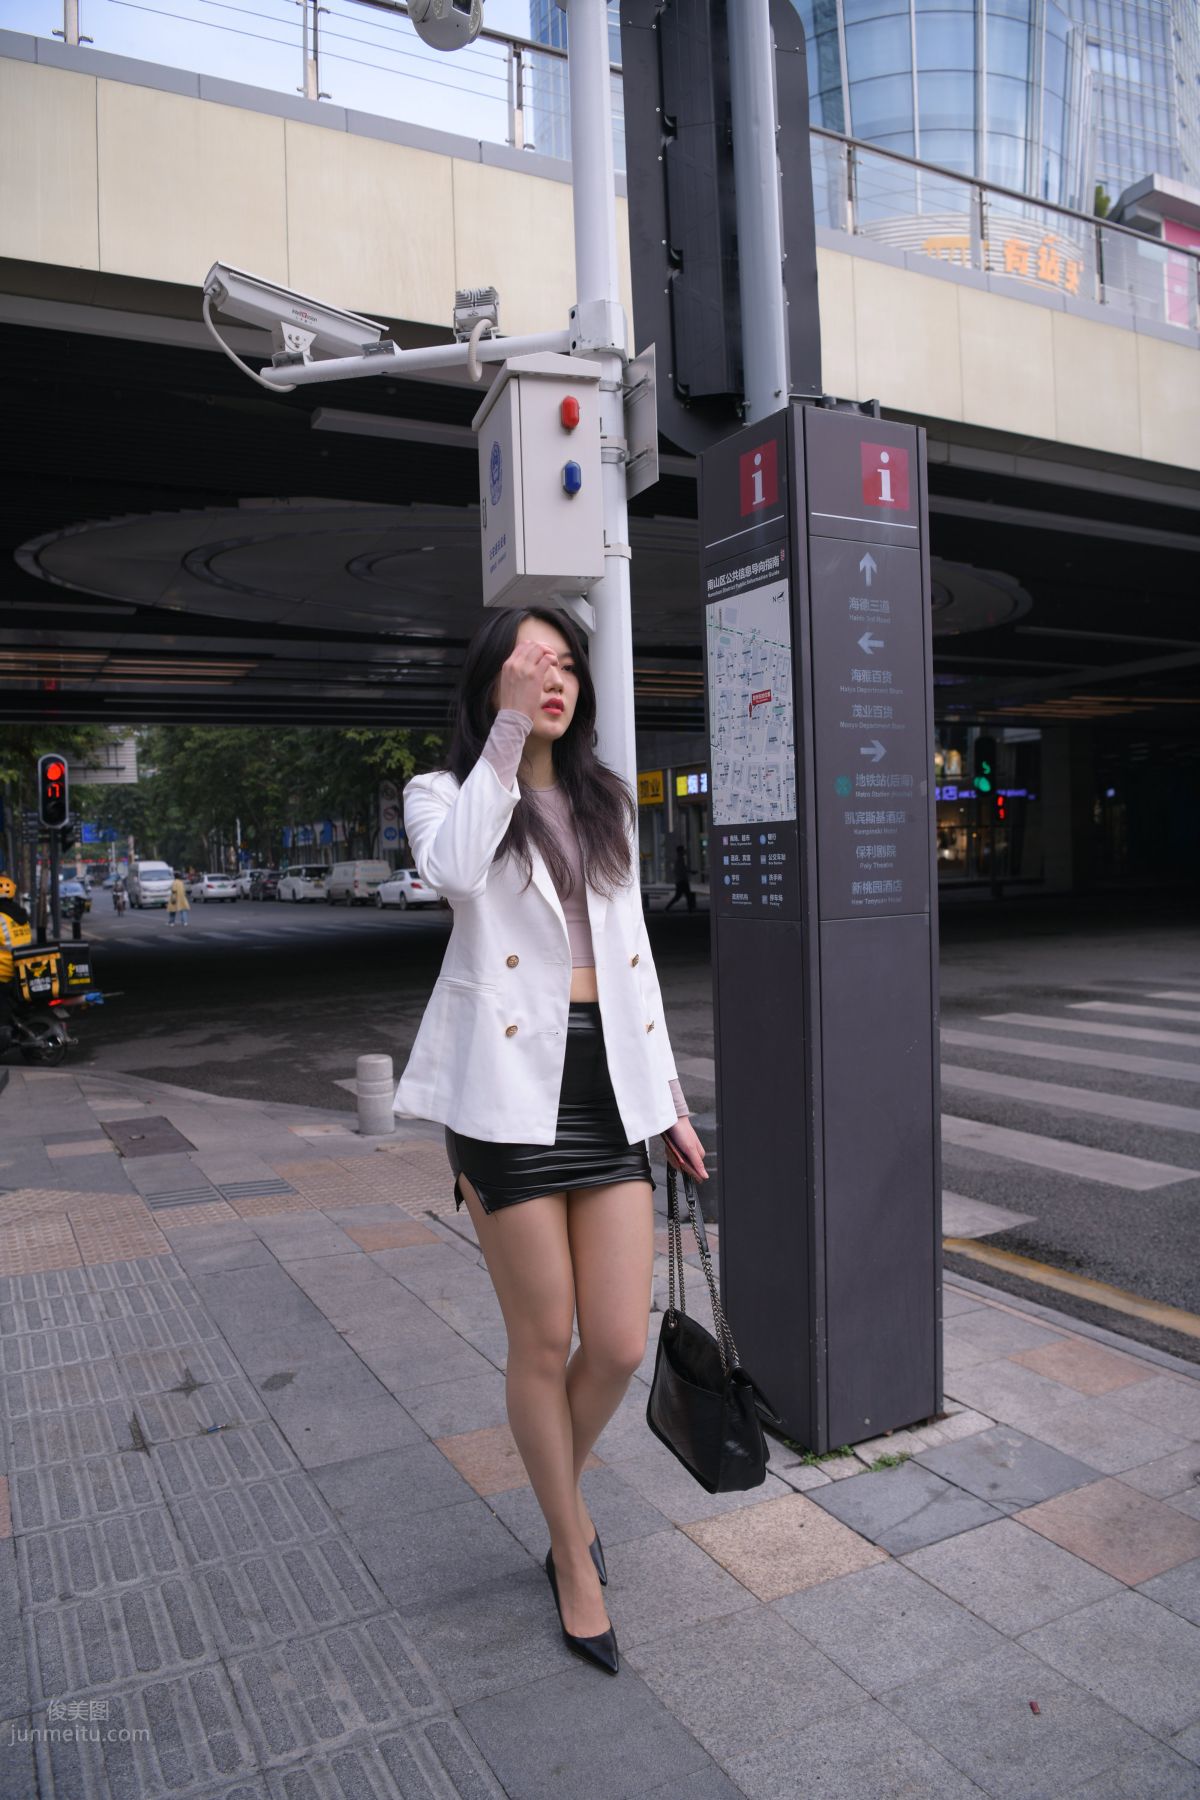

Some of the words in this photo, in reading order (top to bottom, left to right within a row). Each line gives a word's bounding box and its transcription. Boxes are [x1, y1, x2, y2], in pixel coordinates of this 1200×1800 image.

[707, 555, 780, 591] 南山区公共信息导向指南
